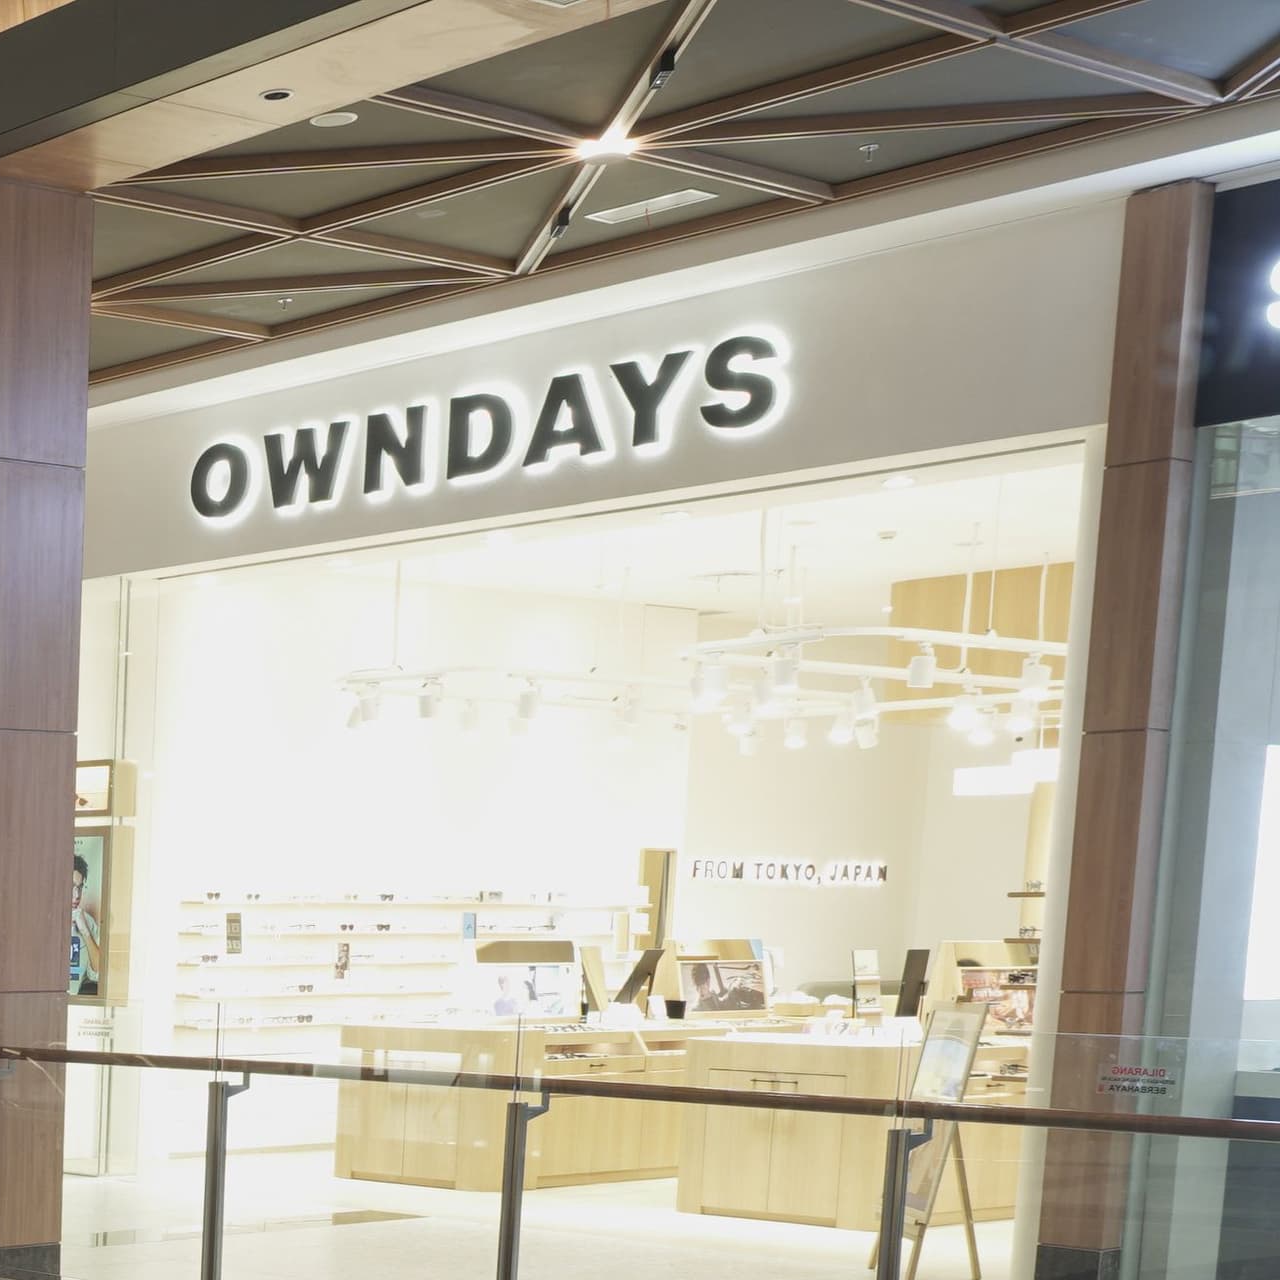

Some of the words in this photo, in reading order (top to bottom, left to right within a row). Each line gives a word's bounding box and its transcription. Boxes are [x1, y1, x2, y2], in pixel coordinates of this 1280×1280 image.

[190, 336, 781, 518] OWNDAYS
[692, 859, 745, 879] FROM
[754, 863, 822, 885] TOKYO,
[830, 864, 889, 882] JAPAN
